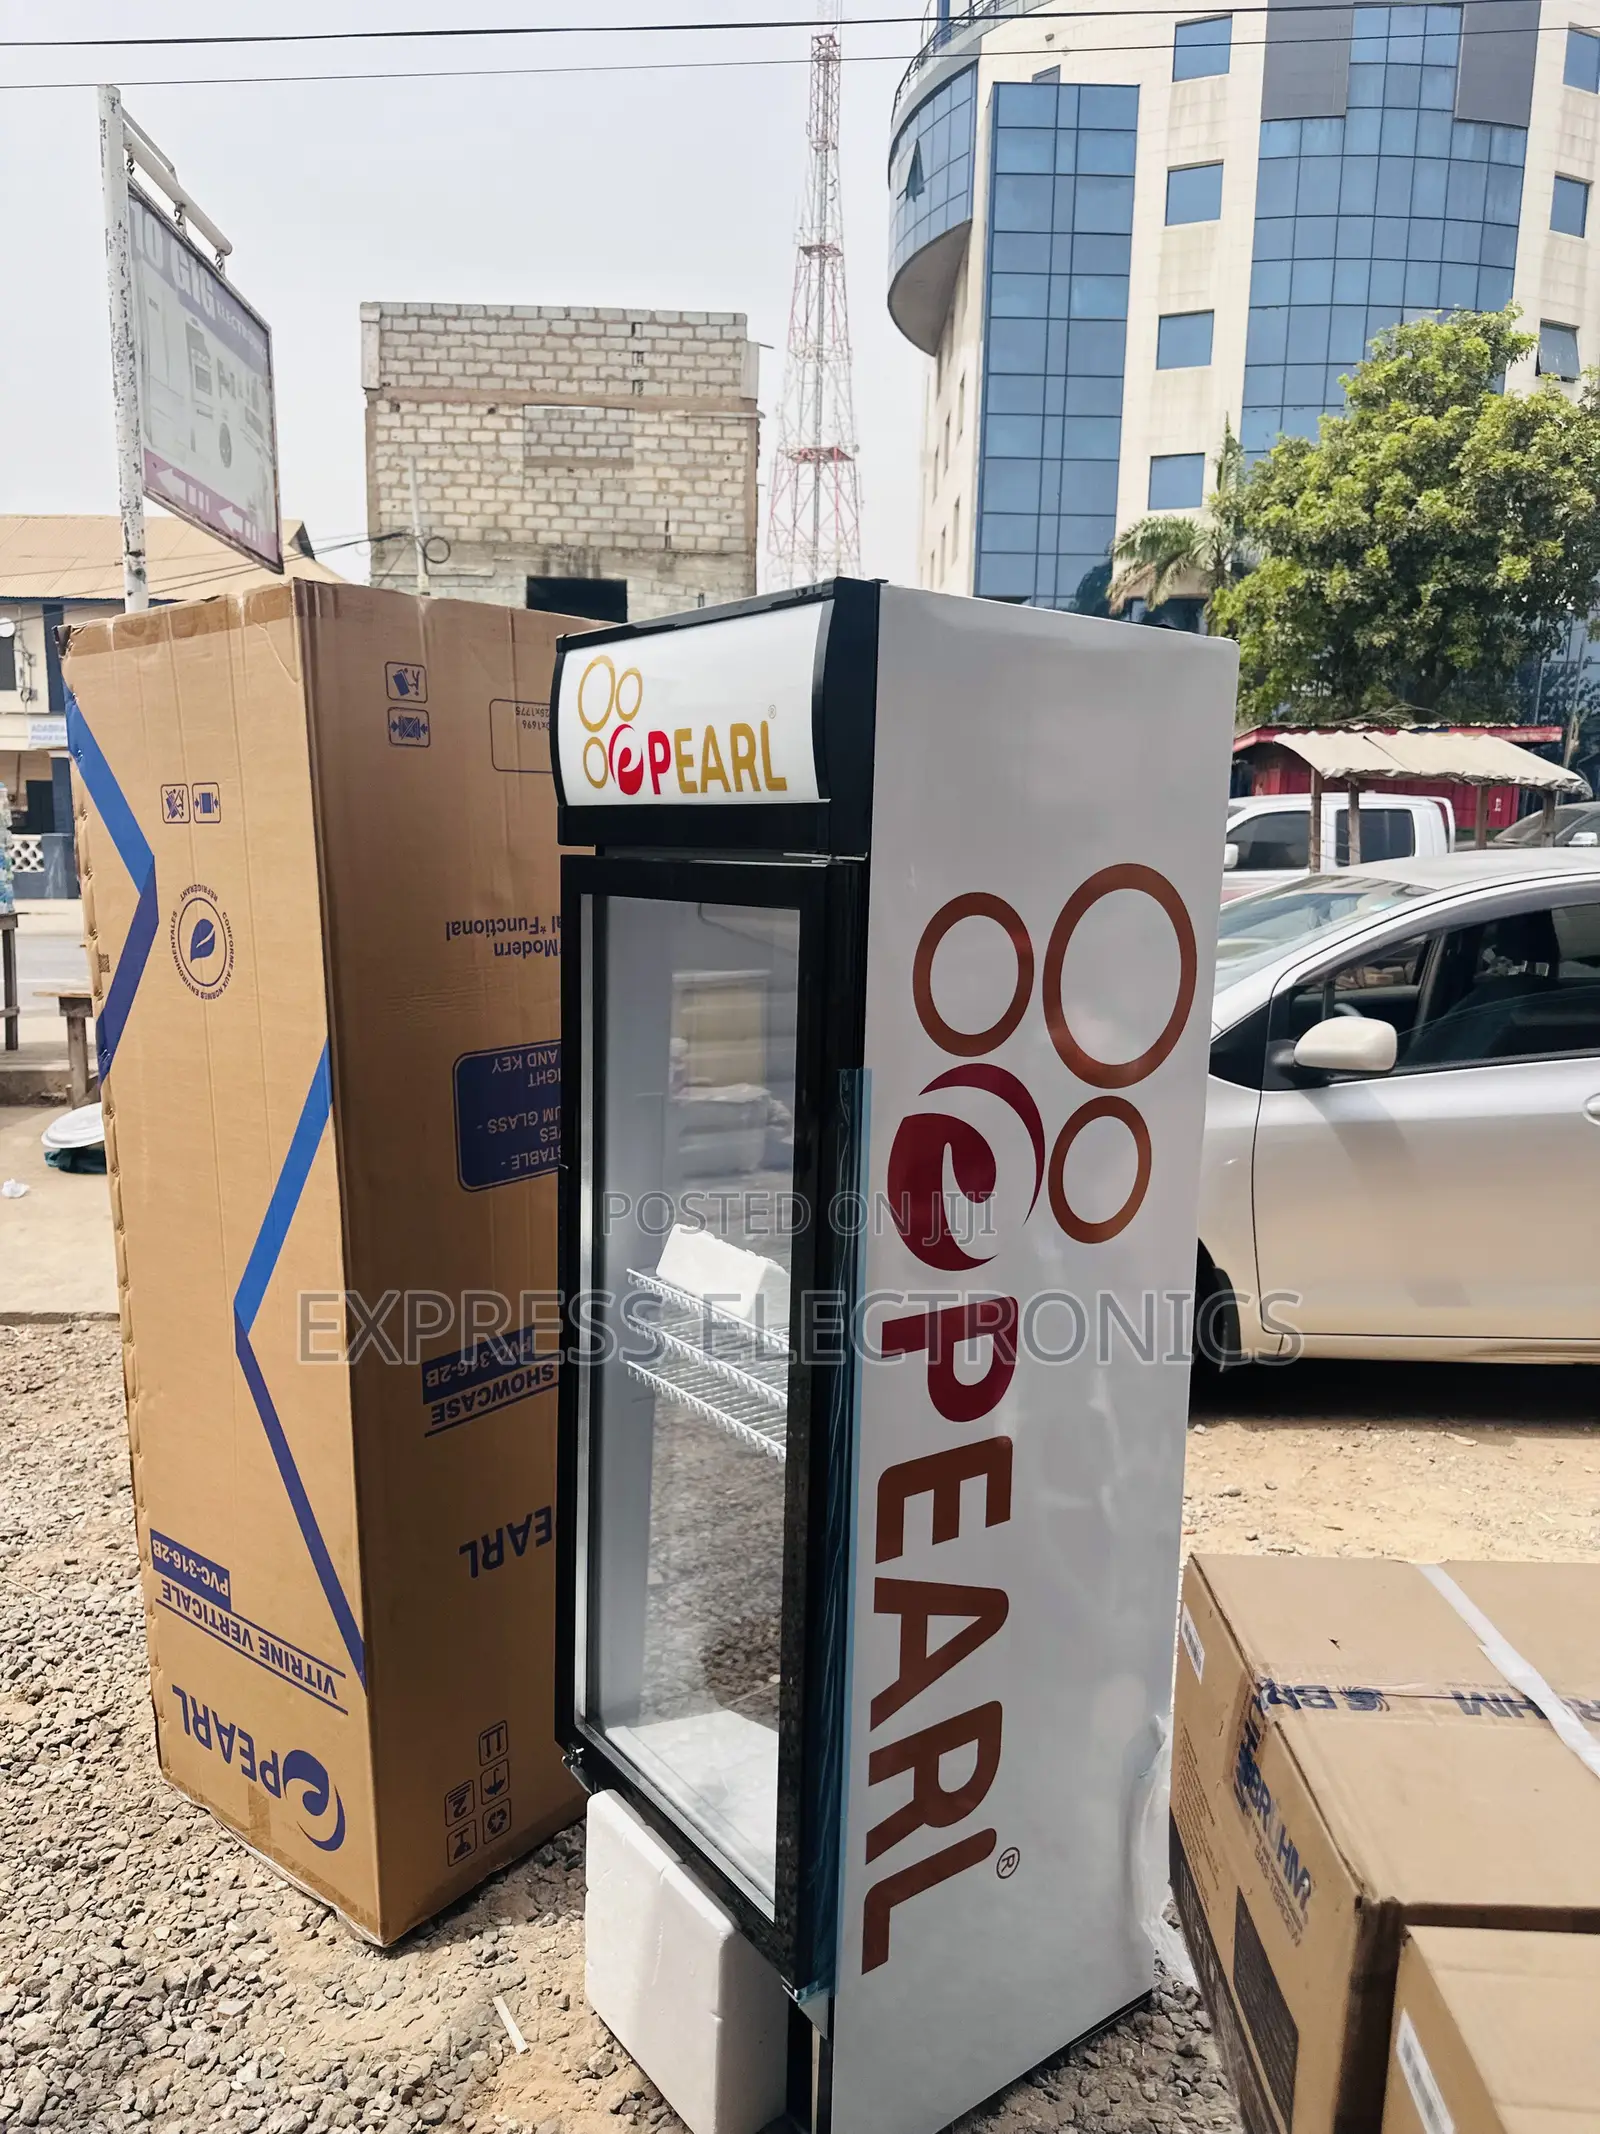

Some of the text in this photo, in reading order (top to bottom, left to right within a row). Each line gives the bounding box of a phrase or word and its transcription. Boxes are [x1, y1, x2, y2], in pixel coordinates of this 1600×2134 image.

[648, 721, 787, 795] PEARL
[491, 1048, 558, 1073] AND KEY
[487, 1110, 538, 1134] GLASS
[431, 1362, 555, 1426] SHOWCASE
[152, 1538, 229, 1597] PVC-316-2B
[458, 1505, 553, 1579] EARL
[161, 1578, 338, 1700] VITRINE VERTICALE
[861, 1296, 1018, 1976] PEARL
[172, 1684, 282, 1799] PEARL
